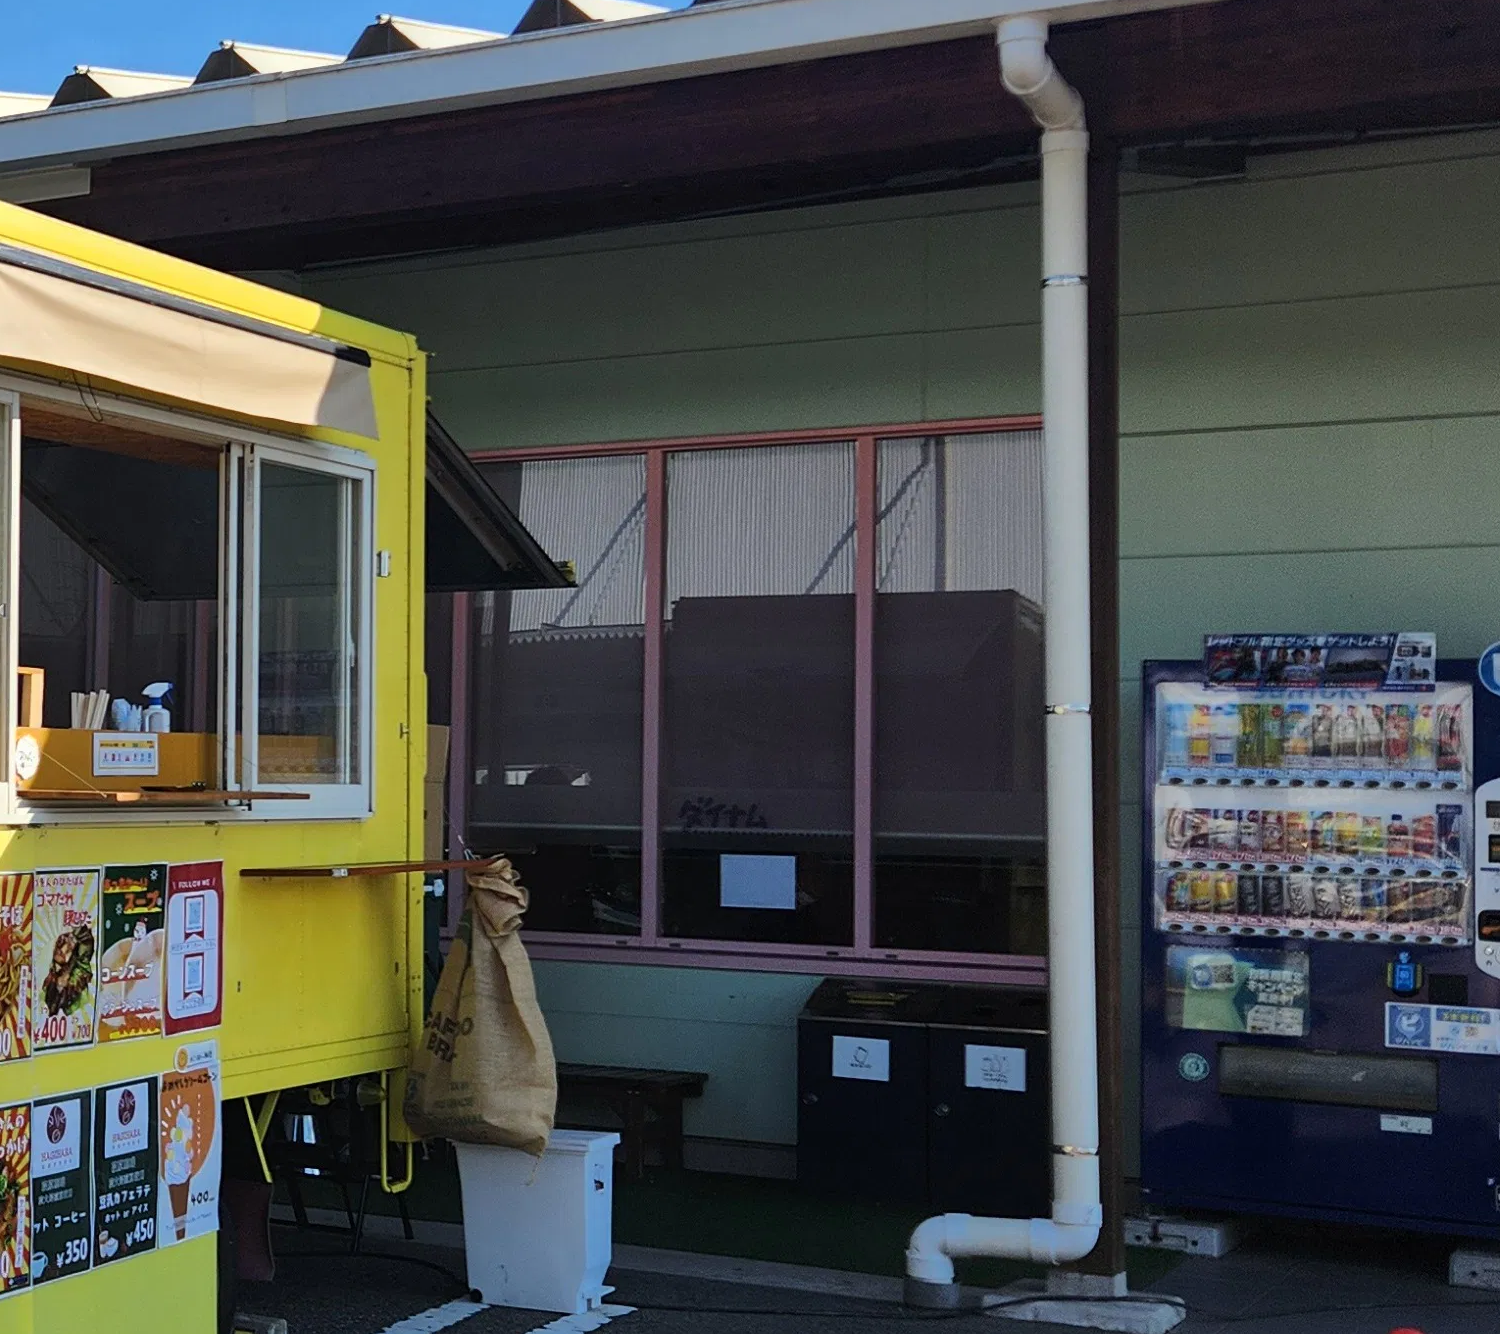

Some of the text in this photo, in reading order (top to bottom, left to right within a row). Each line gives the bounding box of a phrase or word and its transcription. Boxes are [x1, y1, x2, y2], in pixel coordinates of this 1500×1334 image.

[124, 890, 160, 912] スープ
[101, 962, 155, 982] コーンスープ
[33, 1015, 68, 1044] ¥400
[98, 1184, 152, 1211] 豆乳カフェラテ
[54, 1211, 87, 1228] コーヒー
[125, 1217, 155, 1247] ¥450
[56, 1237, 88, 1268] ¥350
